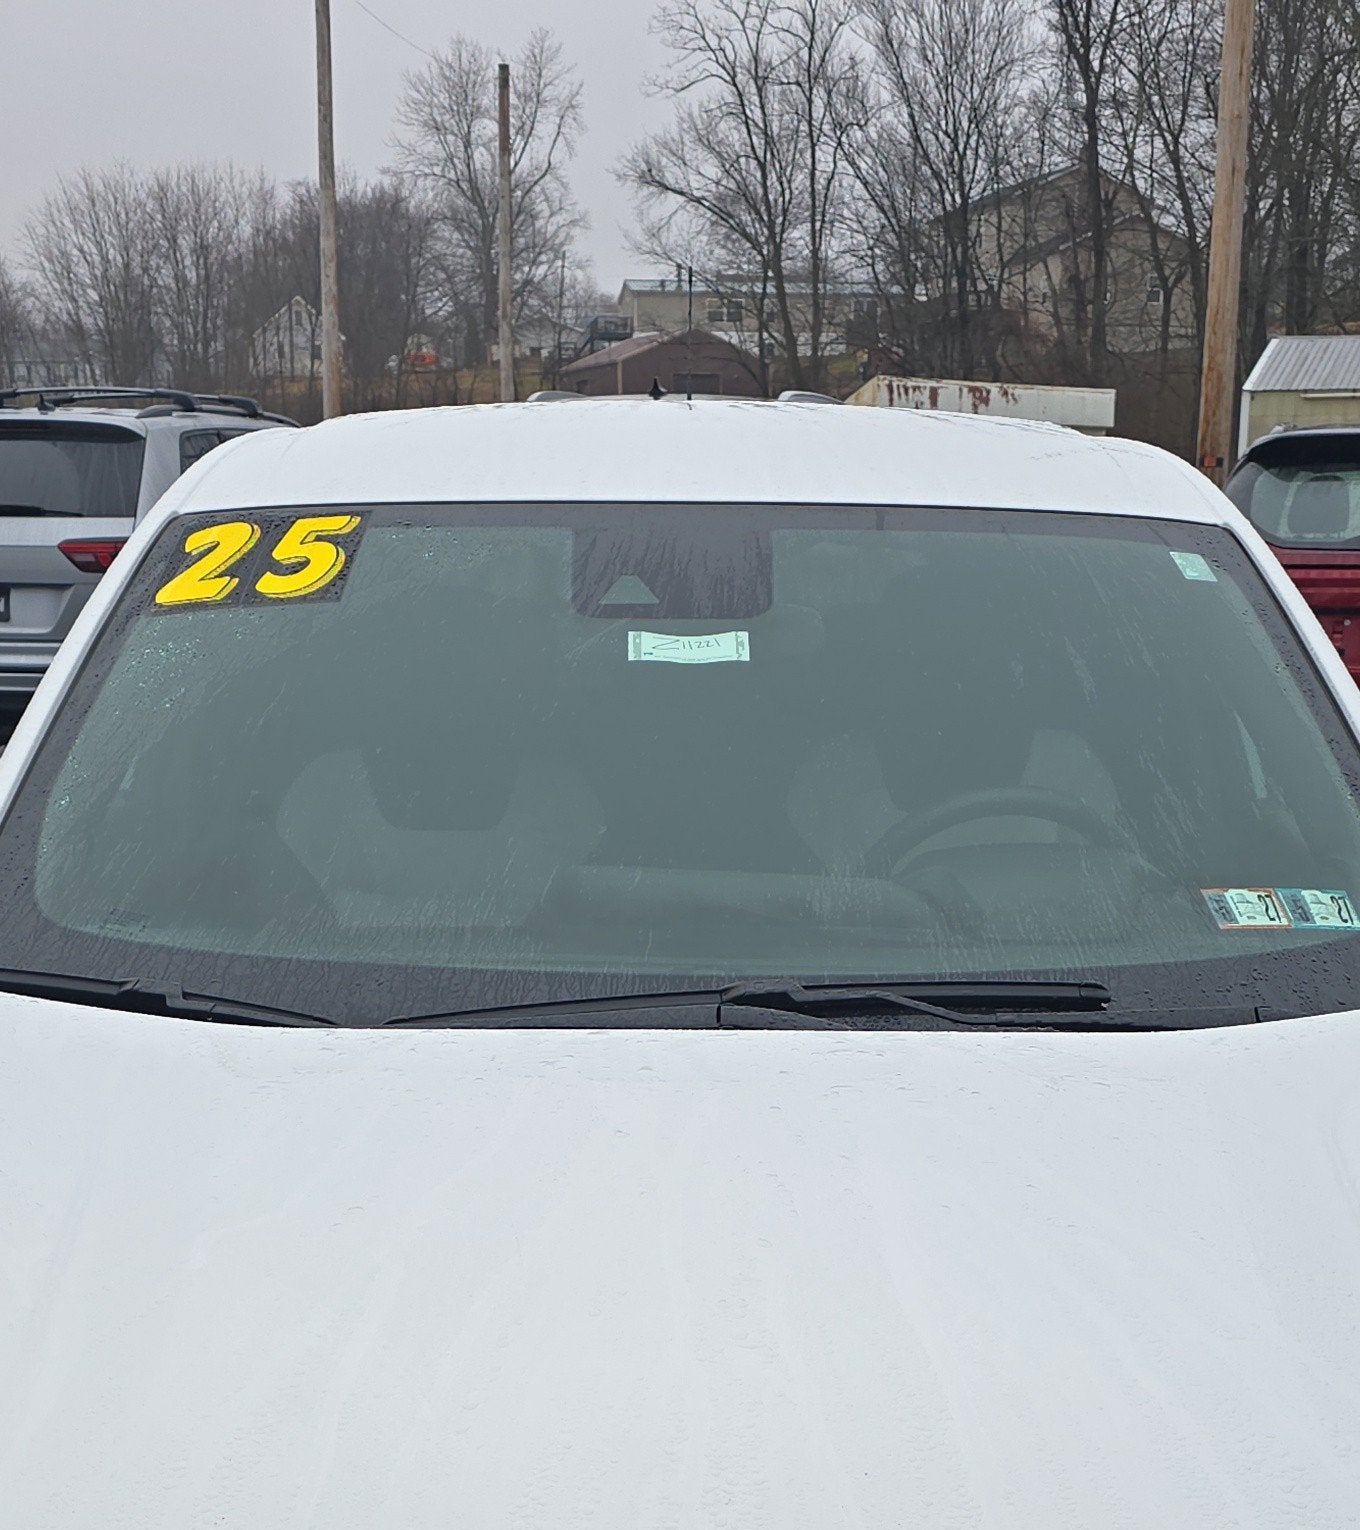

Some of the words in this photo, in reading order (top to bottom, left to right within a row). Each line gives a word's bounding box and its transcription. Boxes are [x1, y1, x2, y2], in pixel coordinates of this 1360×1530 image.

[155, 515, 362, 607] 25
[1257, 894, 1283, 923] 27
[1330, 895, 1355, 925] 27
